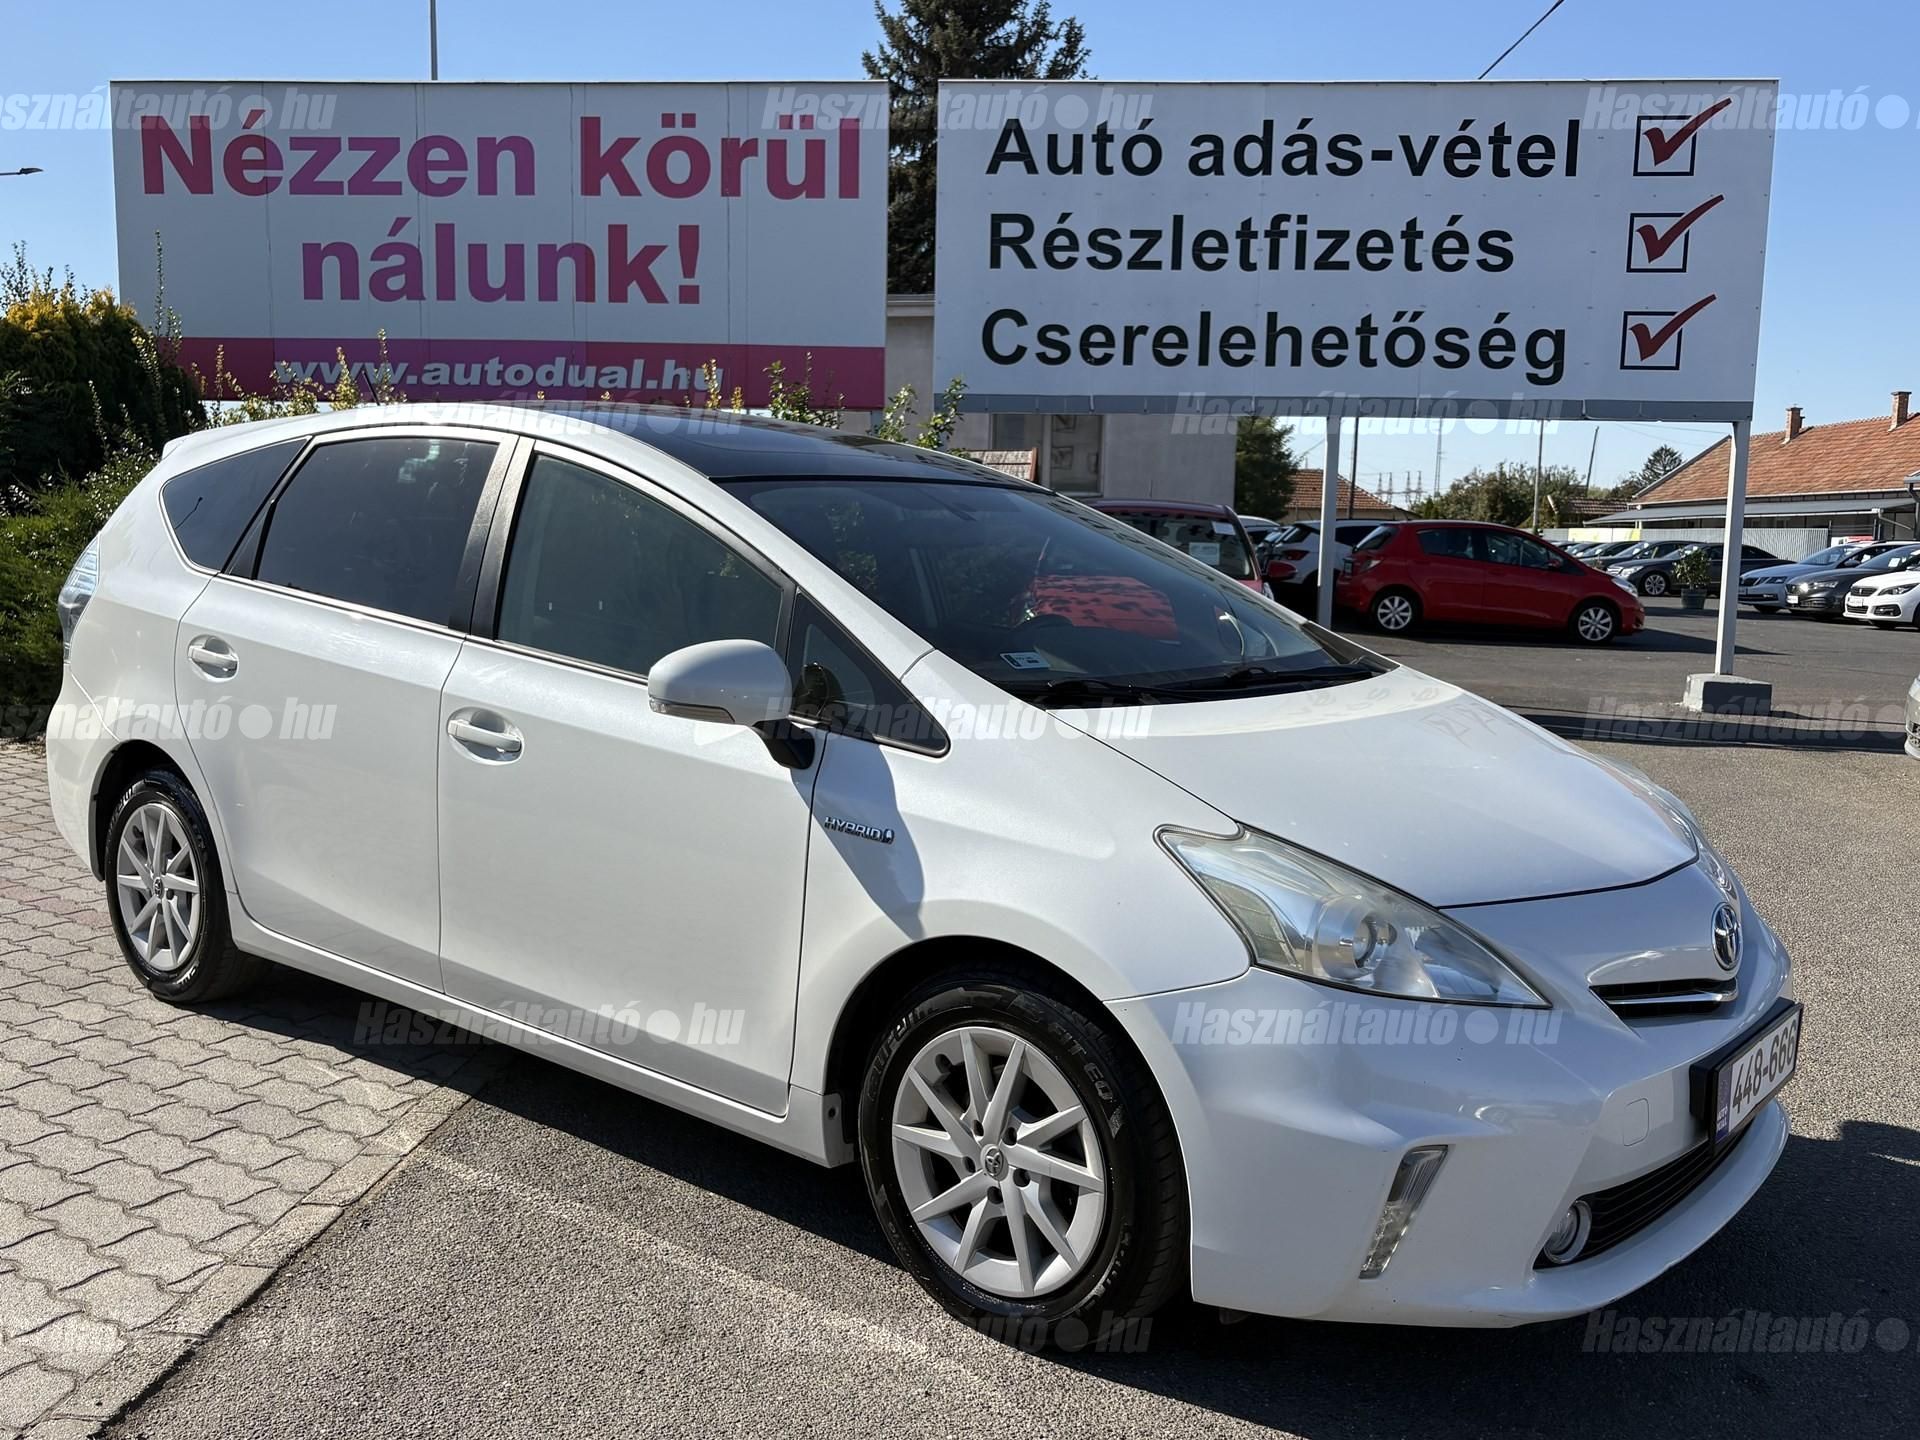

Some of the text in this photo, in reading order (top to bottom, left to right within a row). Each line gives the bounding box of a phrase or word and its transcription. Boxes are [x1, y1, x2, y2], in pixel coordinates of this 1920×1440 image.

[141, 109, 860, 199] Nézzen körül
[985, 118, 1580, 177] Autó adás-vétel
[302, 217, 700, 304] nálunk!
[989, 212, 1514, 272] Részletfizetés
[274, 358, 724, 391] www.autodual.hu
[982, 308, 1566, 386] Cserelehetőség
[824, 816, 882, 841] HYBRID
[1732, 1020, 1797, 1114] 448-666
